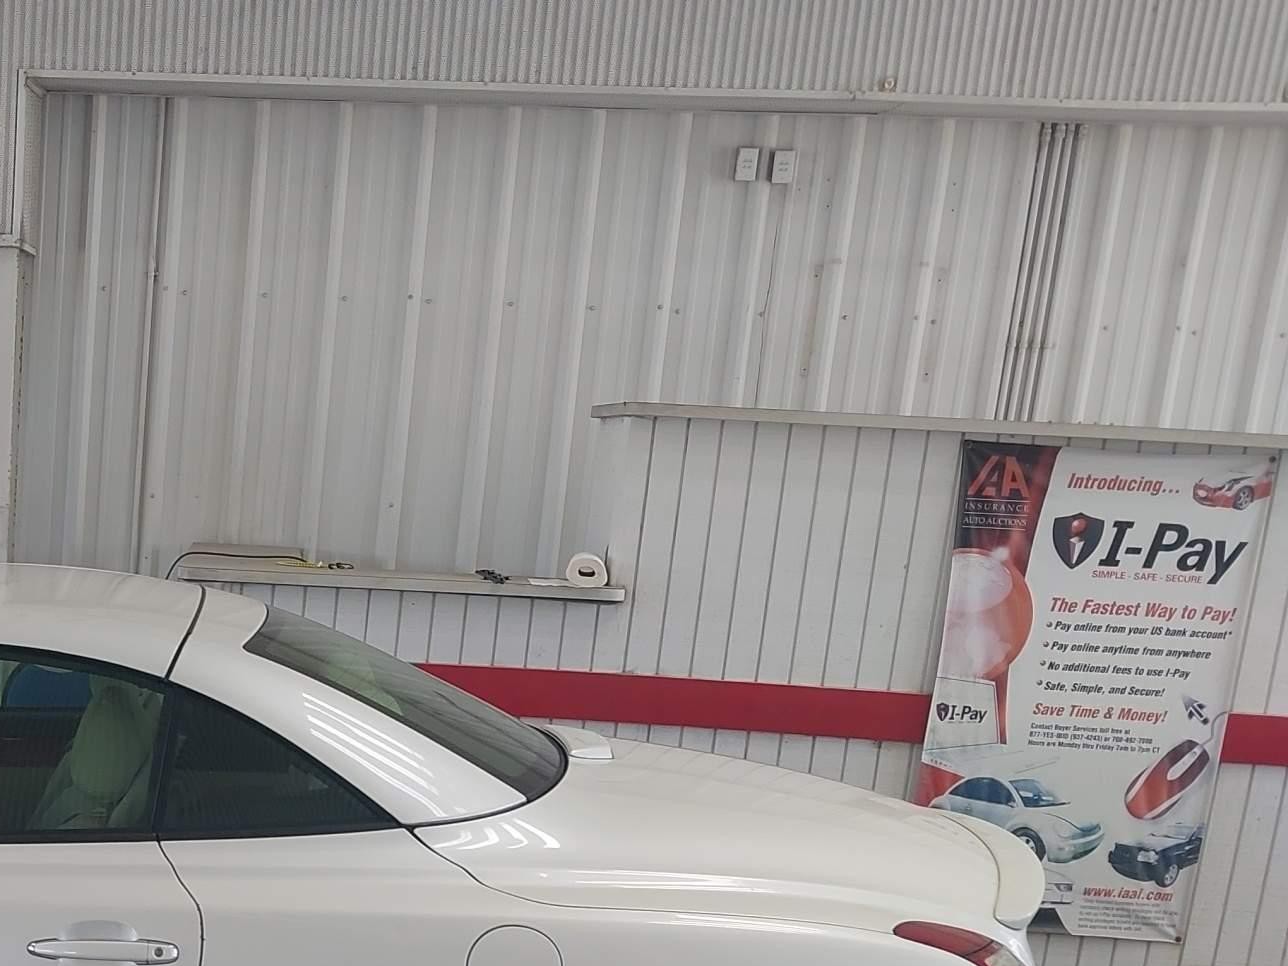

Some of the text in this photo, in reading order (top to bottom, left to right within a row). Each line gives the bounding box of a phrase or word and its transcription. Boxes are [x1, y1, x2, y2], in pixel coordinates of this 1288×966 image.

[1067, 473, 1181, 495] Introducing...
[965, 502, 1030, 513] INSURANCE
[963, 516, 1027, 527] AUTO AUCTIONS
[1098, 520, 1249, 585] I-Pay
[1092, 570, 1126, 580] SIMPLE
[1134, 572, 1158, 582] SAFE
[1166, 574, 1203, 584] SECURE
[1050, 598, 1238, 625] The Fastest Way to Pay!
[1053, 621, 1072, 633] Pay
[1073, 622, 1102, 632] online
[1104, 624, 1126, 634] from
[1128, 627, 1148, 636] your
[1150, 626, 1163, 636] US
[1164, 627, 1188, 637] bank
[1050, 641, 1212, 660] Pay online anytime from anywhere
[1047, 661, 1191, 680] No additional fees to use I-Pay
[1044, 681, 1165, 697] Safe, Simple, and Secure!
[948, 704, 988, 723] I-Pay
[1032, 702, 1168, 725] Save Time & Money!
[1030, 722, 1054, 731] Contact
[1054, 724, 1072, 732] Buyer
[1072, 725, 1098, 733] Services
[1058, 741, 1081, 750] Monday
[1095, 744, 1114, 752] Friday
[1083, 886, 1173, 901] www.iaai.com
